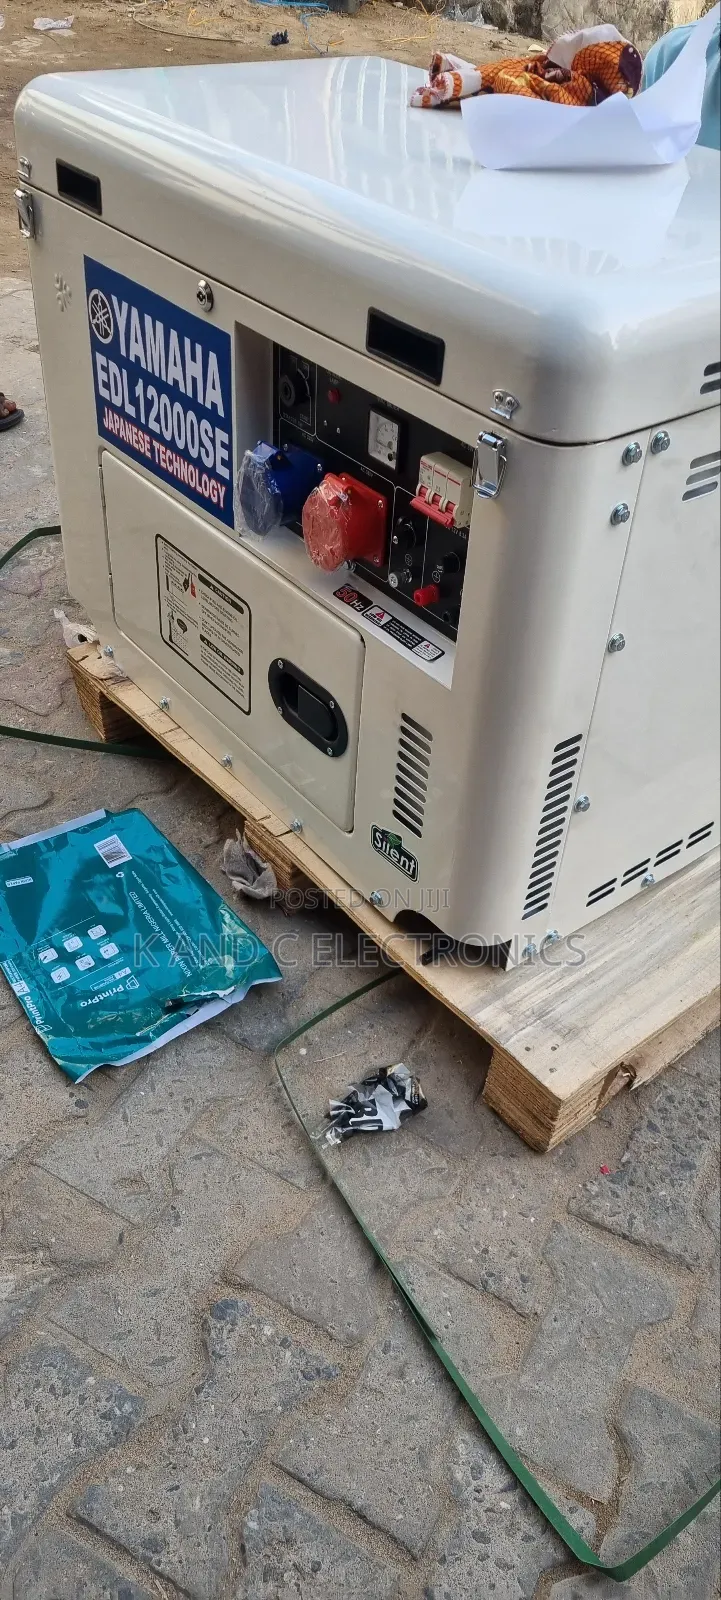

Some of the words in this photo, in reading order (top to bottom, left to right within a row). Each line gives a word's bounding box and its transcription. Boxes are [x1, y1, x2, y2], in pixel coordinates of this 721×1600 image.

[111, 294, 225, 418] YAMAHA
[95, 351, 230, 480] EDL12000SE
[103, 407, 151, 460] JAPANESE
[152, 441, 226, 509] TECHNOLOGY
[336, 586, 363, 612] 50Hz
[374, 832, 416, 875] Silent
[128, 889, 146, 912] LIMITED
[142, 909, 160, 932] NIGERIA
[156, 930, 169, 944] MILL
[14, 982, 28, 993] A4
[79, 984, 124, 1008] PrintPro
[24, 995, 44, 1025] PrintPro
